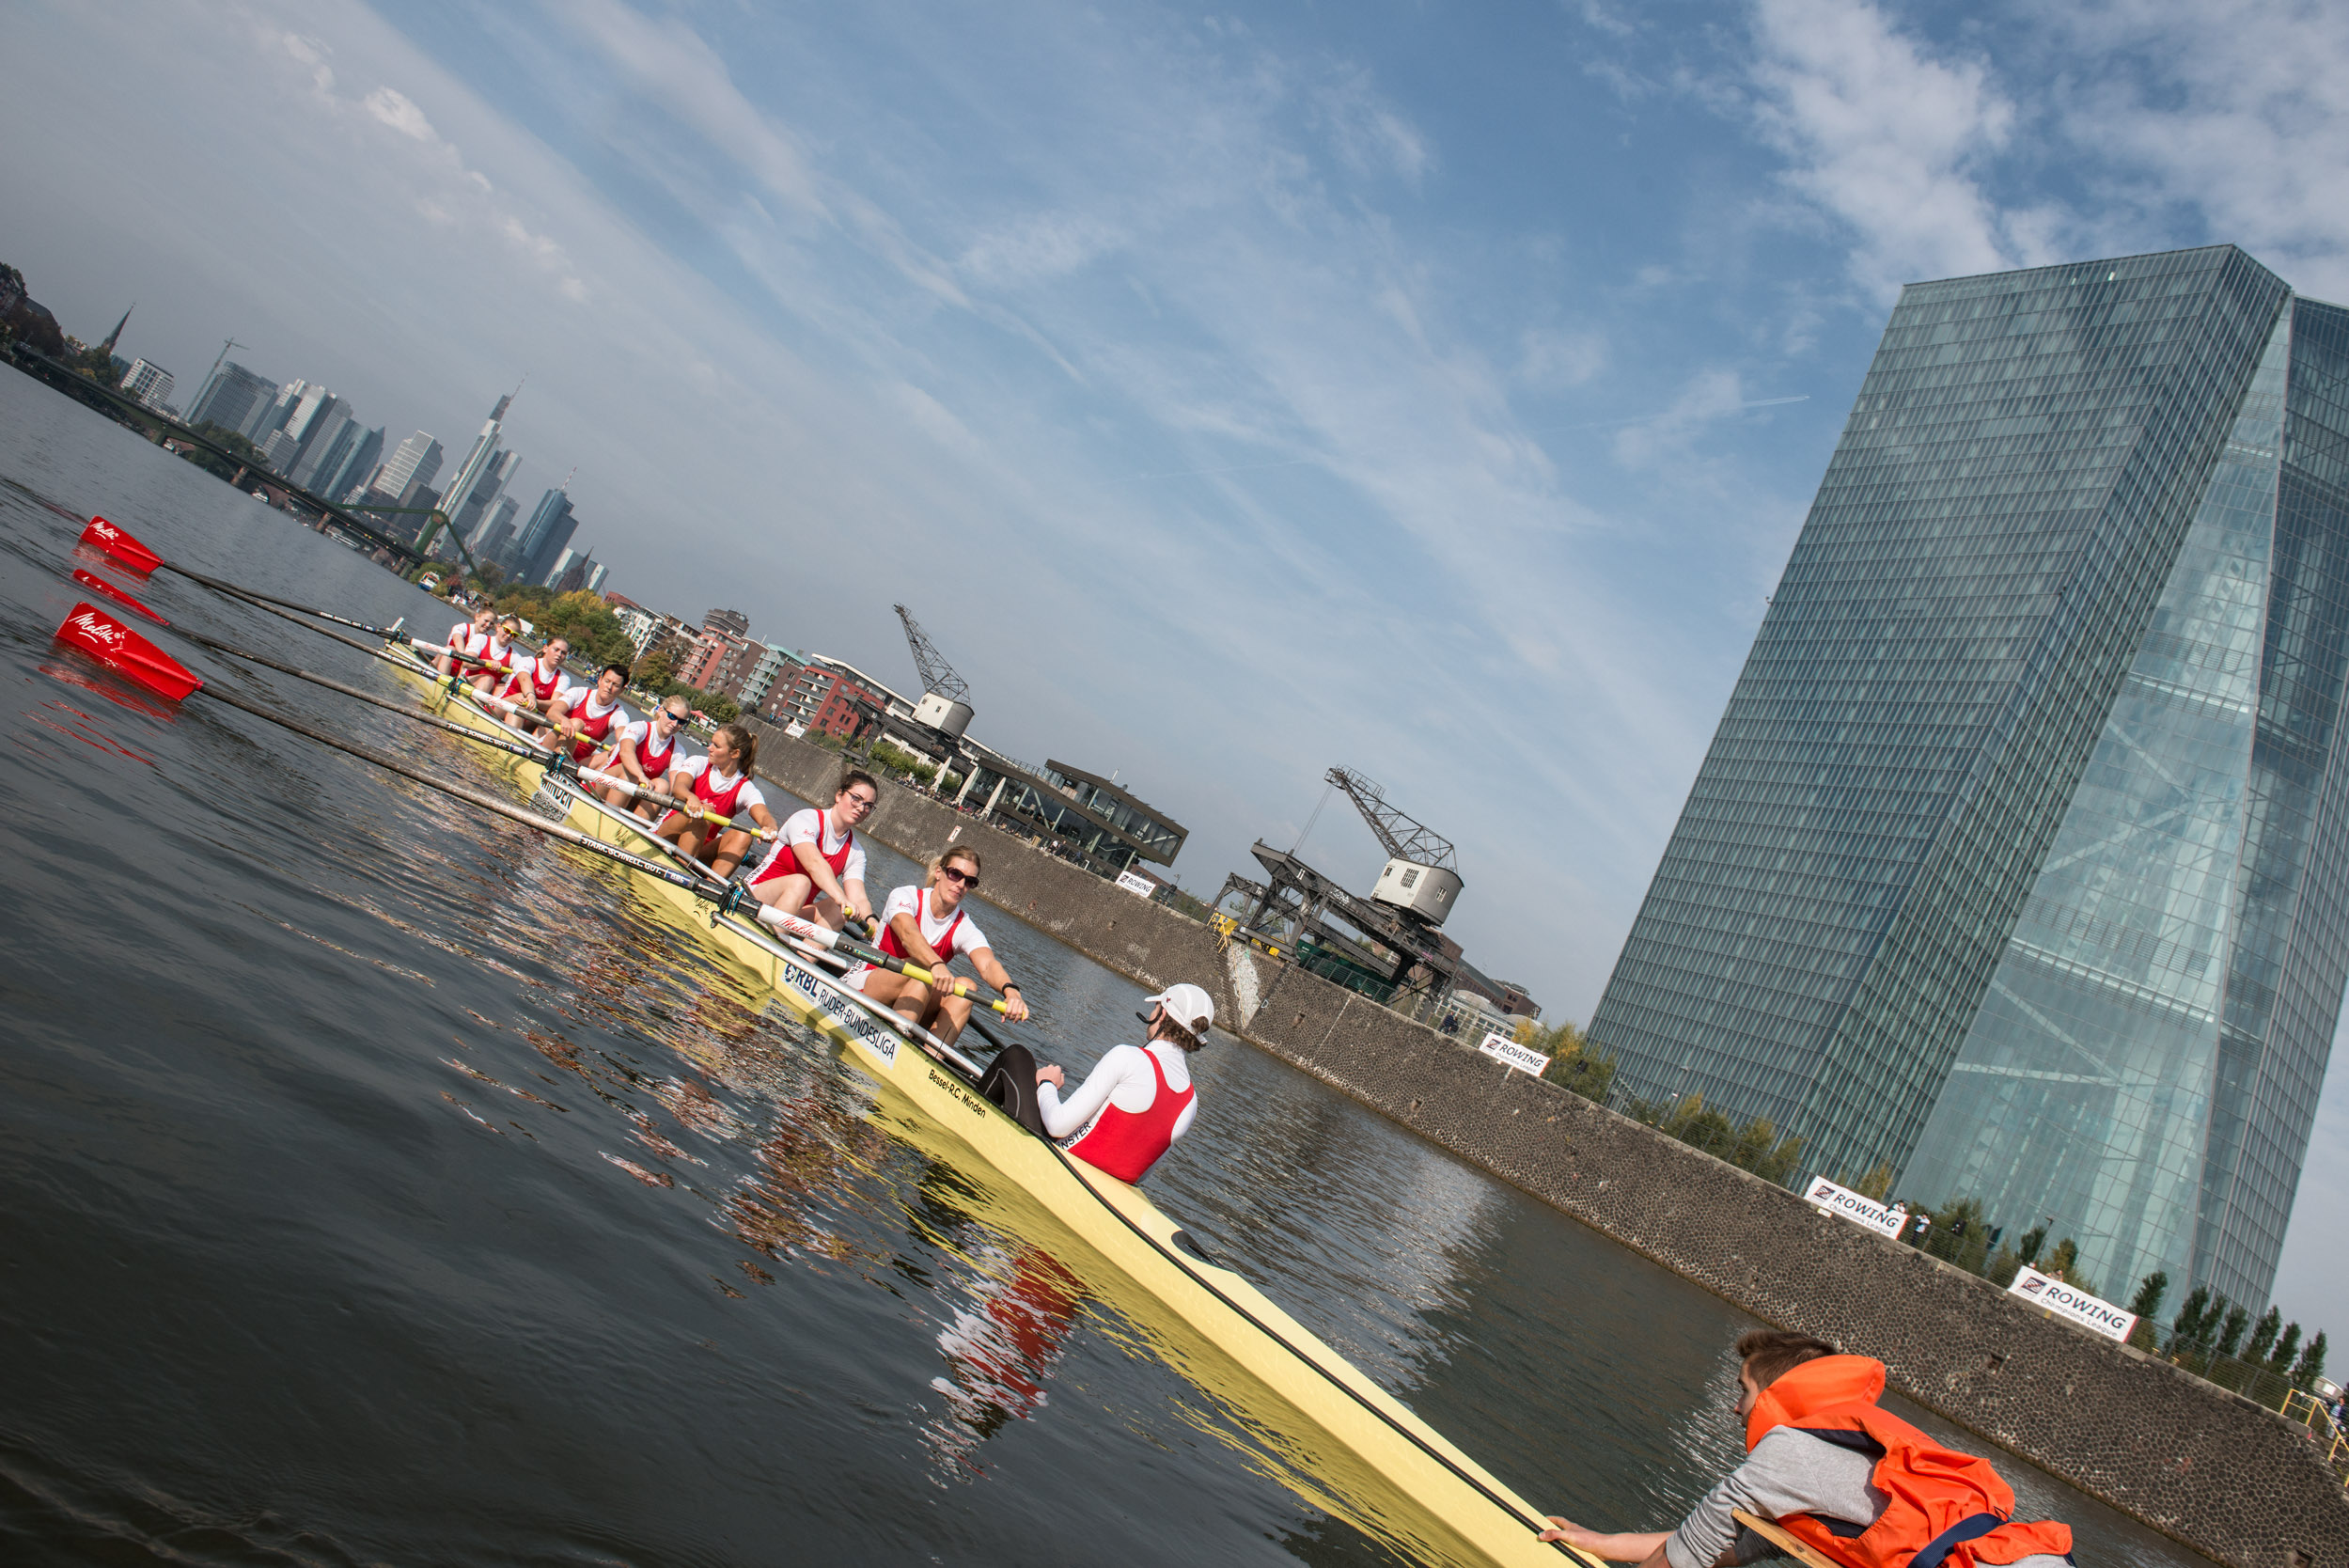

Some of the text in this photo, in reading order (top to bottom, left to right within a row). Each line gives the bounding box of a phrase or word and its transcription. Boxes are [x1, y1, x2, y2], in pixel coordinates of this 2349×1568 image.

[69, 613, 114, 644] Melitta
[608, 845, 644, 869] SCHNELL.
[644, 862, 662, 875] GUT.
[777, 916, 815, 940] Melitta
[795, 969, 819, 998] RBL
[818, 989, 897, 1060] RUDER-BUNDESLIGA
[1499, 1043, 1544, 1068] ROWING
[961, 1093, 987, 1119] Minden
[1828, 1203, 1892, 1235] Champions League
[1833, 1193, 1900, 1228] ROWING
[2040, 1297, 2119, 1339] Champions League
[2045, 1286, 2127, 1330] ROWING
